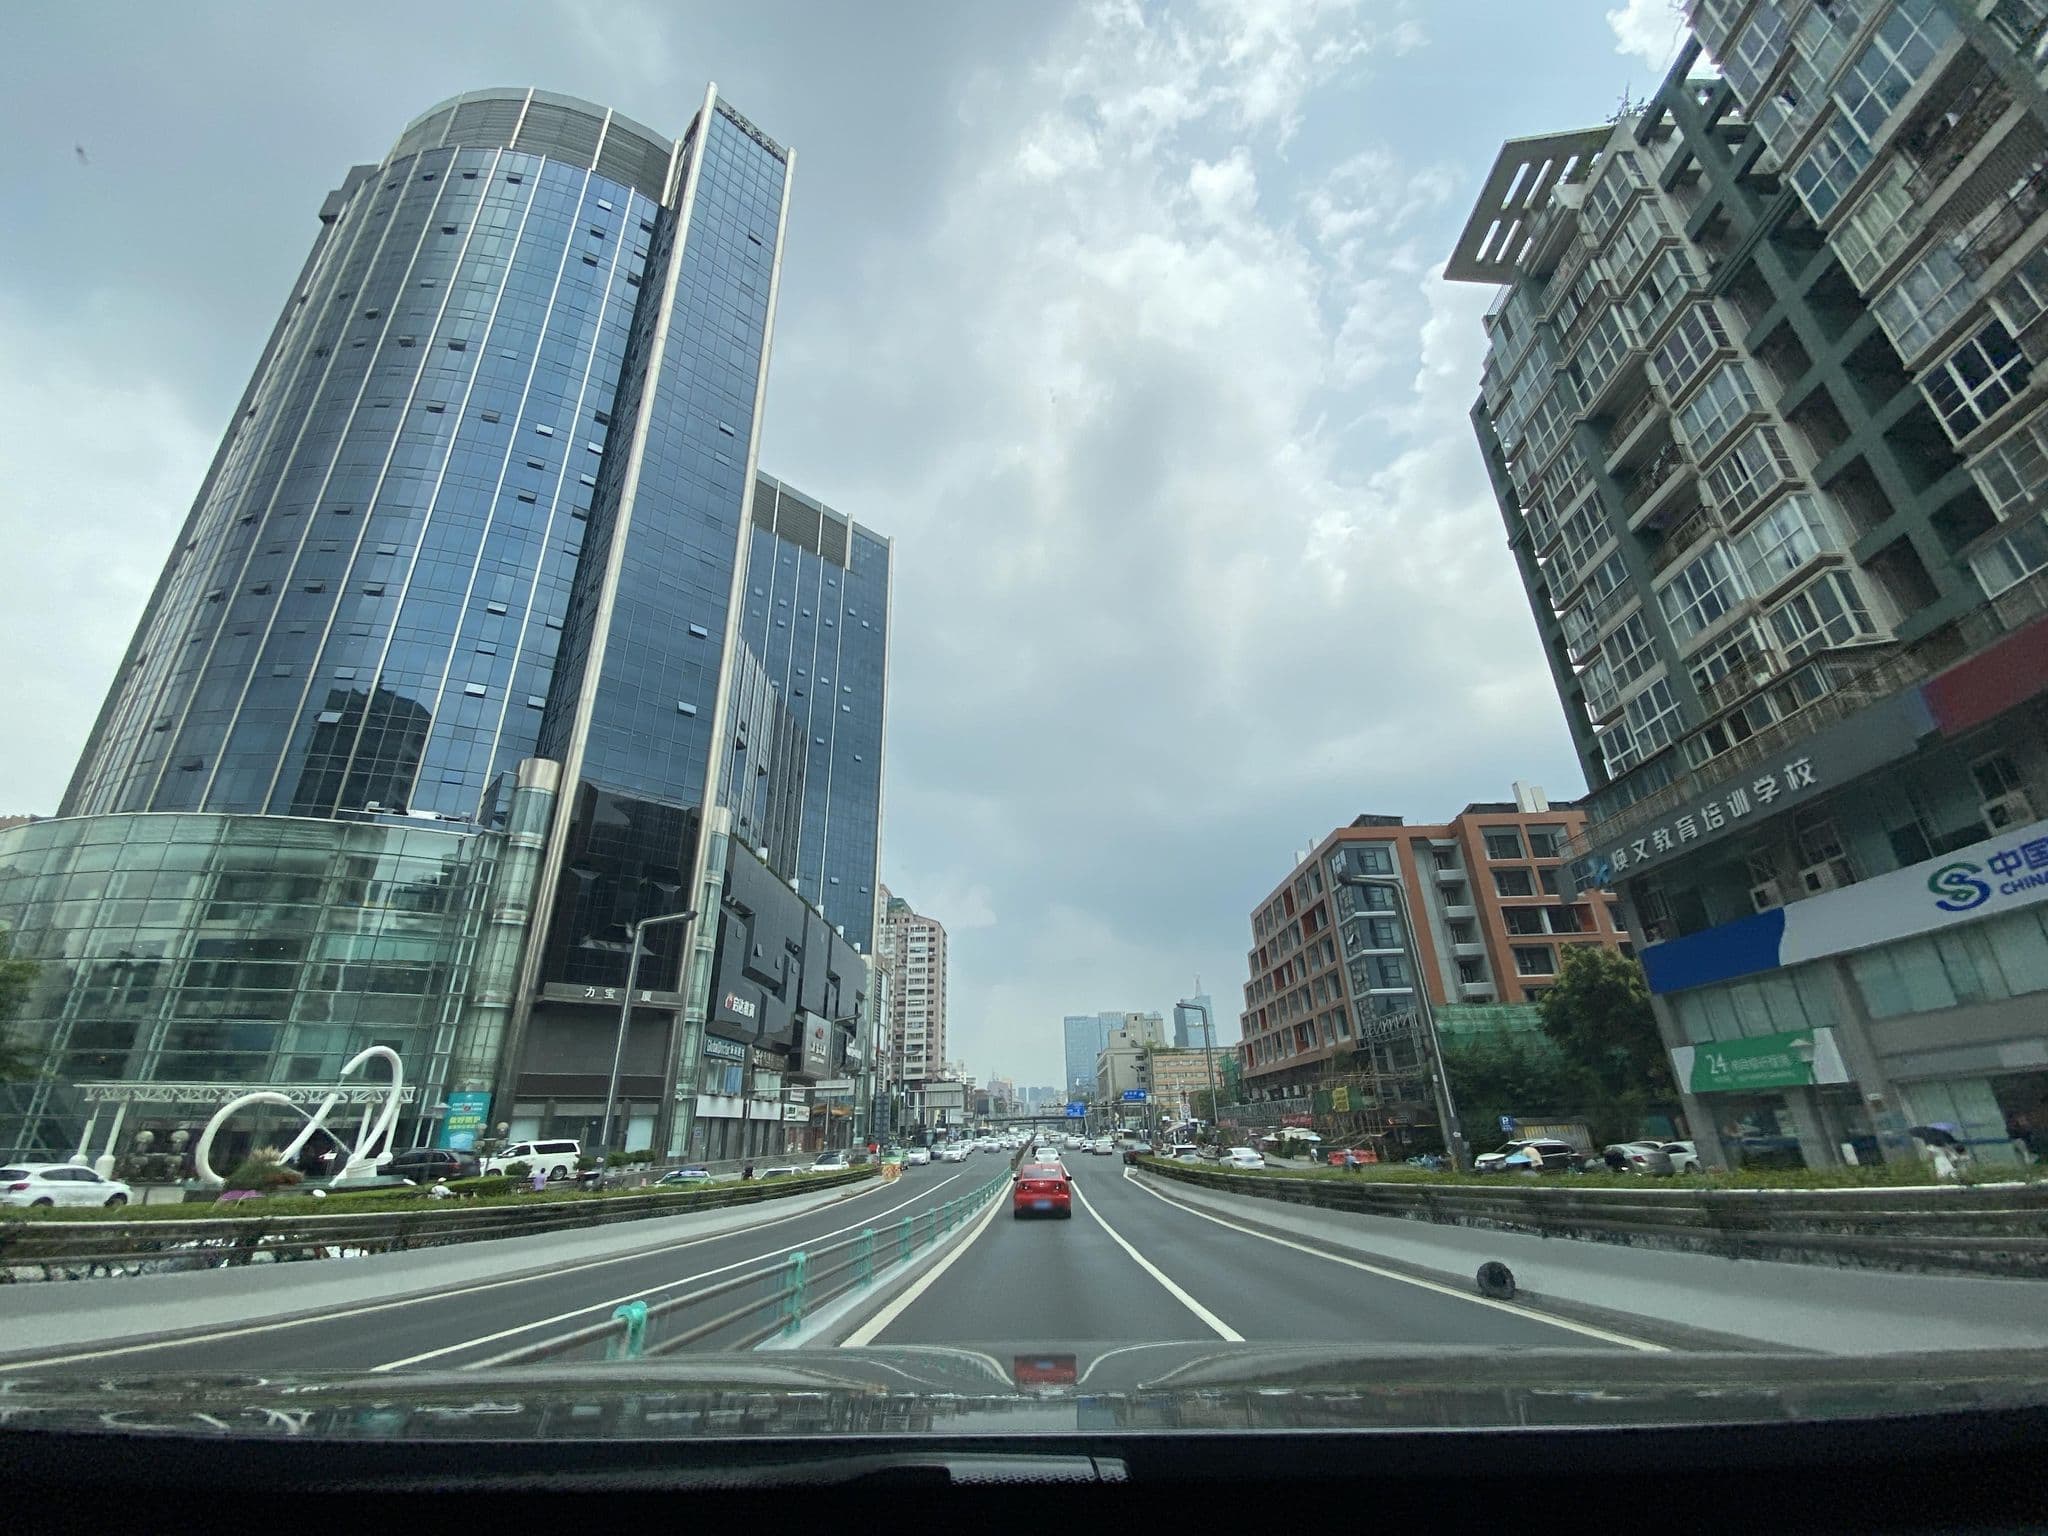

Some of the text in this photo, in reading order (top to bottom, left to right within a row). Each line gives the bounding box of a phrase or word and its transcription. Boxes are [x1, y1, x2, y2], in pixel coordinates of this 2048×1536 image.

[584, 986, 653, 1001] 力宝厦
[1705, 1053, 1727, 1074] 24
